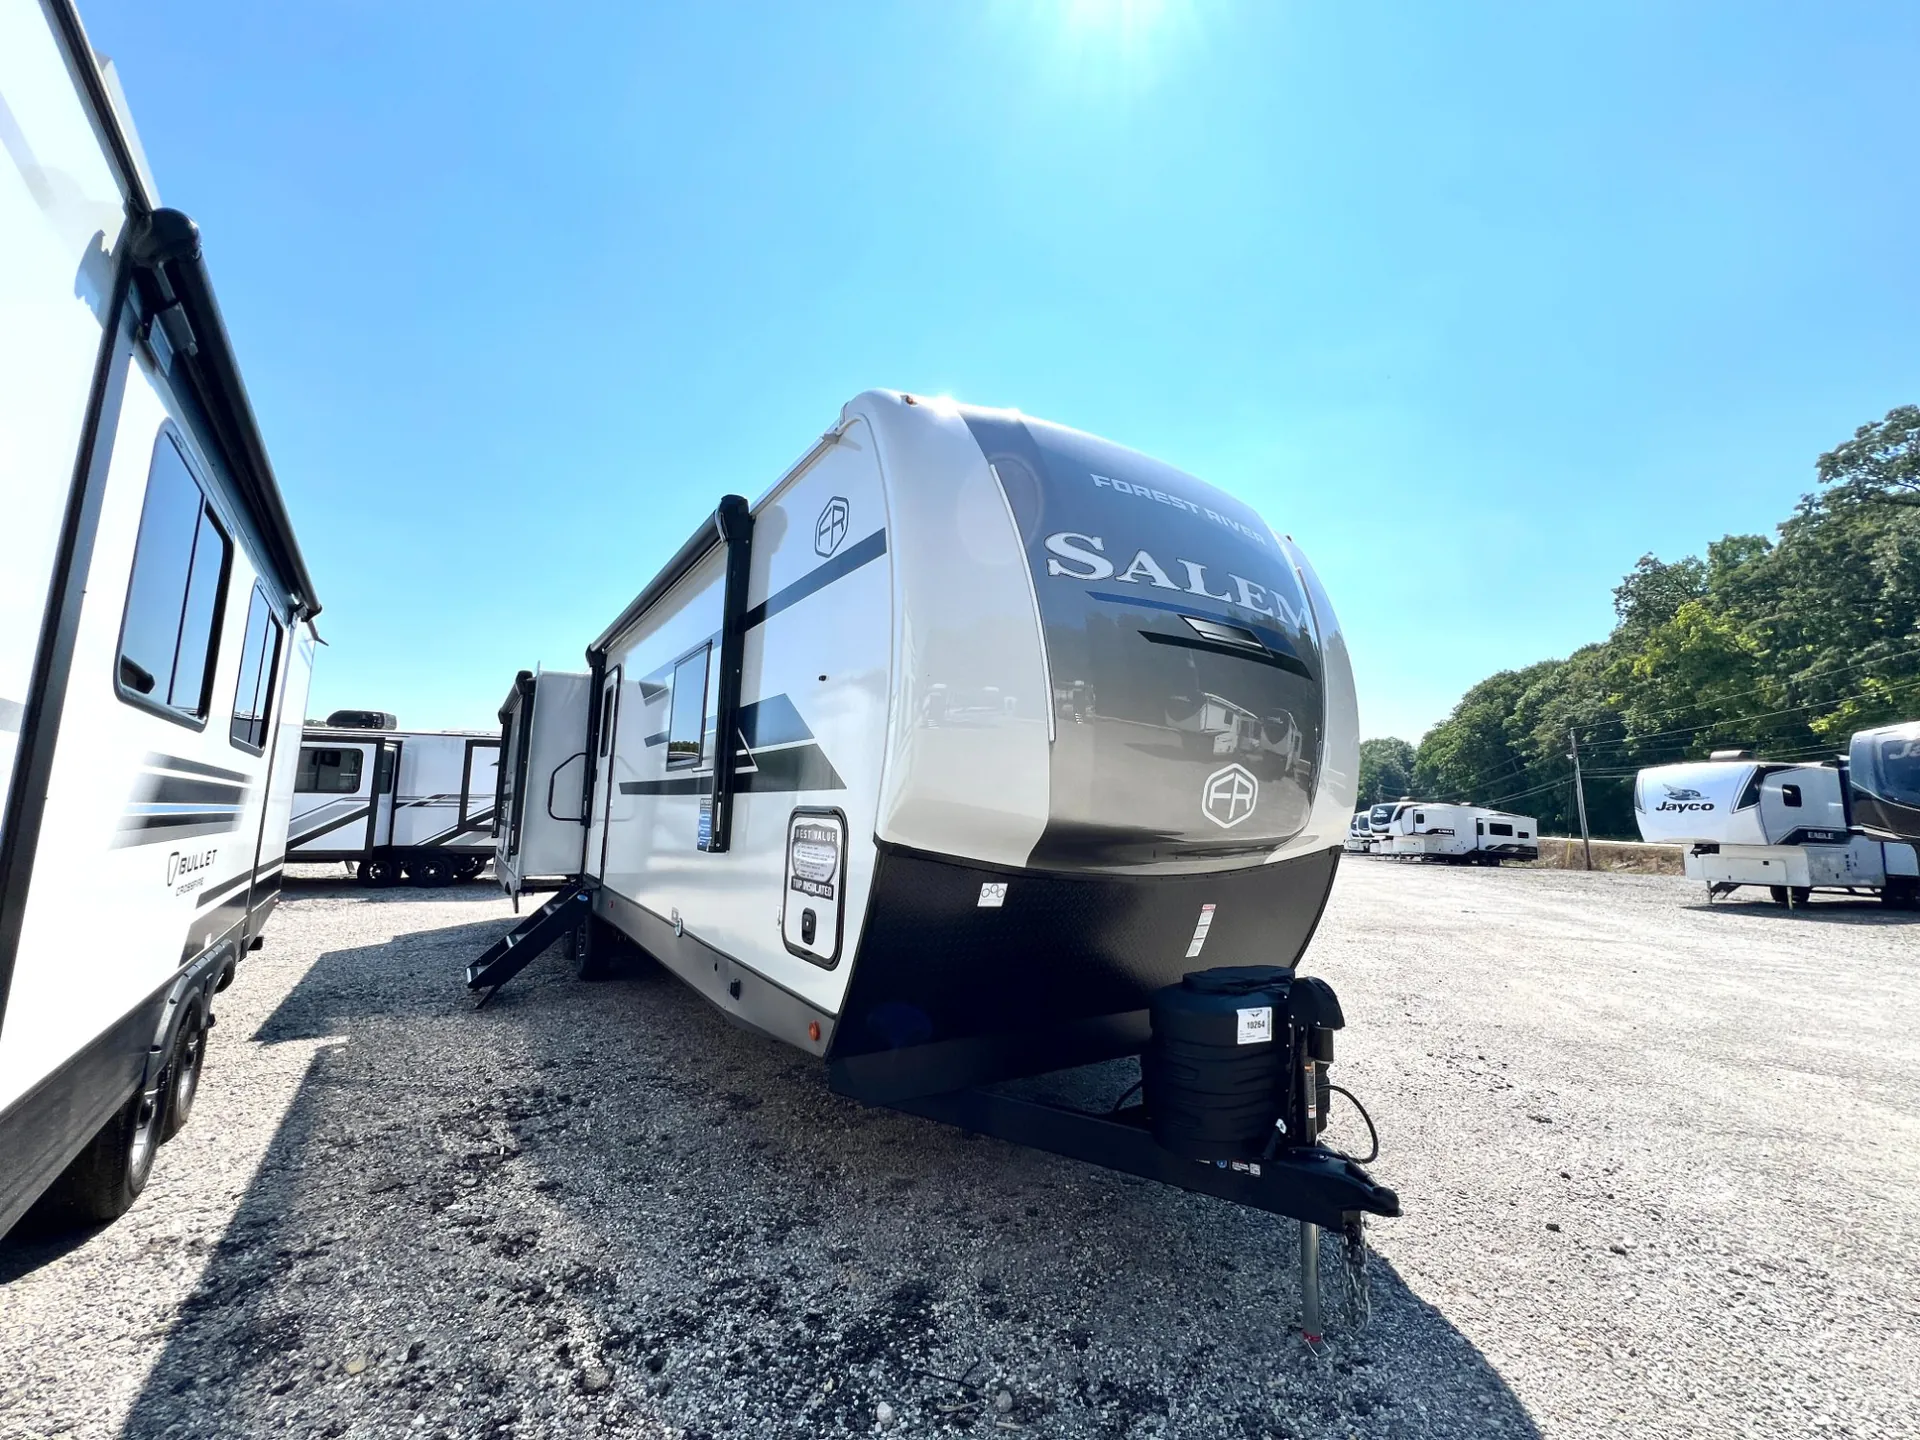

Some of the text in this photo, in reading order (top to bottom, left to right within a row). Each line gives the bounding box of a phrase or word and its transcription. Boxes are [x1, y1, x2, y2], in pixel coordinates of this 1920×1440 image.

[1090, 473, 1268, 545] FOREST RIVER
[1044, 531, 1313, 635] SALEM
[1655, 801, 1715, 813] Jayco
[812, 830, 836, 842] VALUE
[179, 849, 218, 875] BULLET
